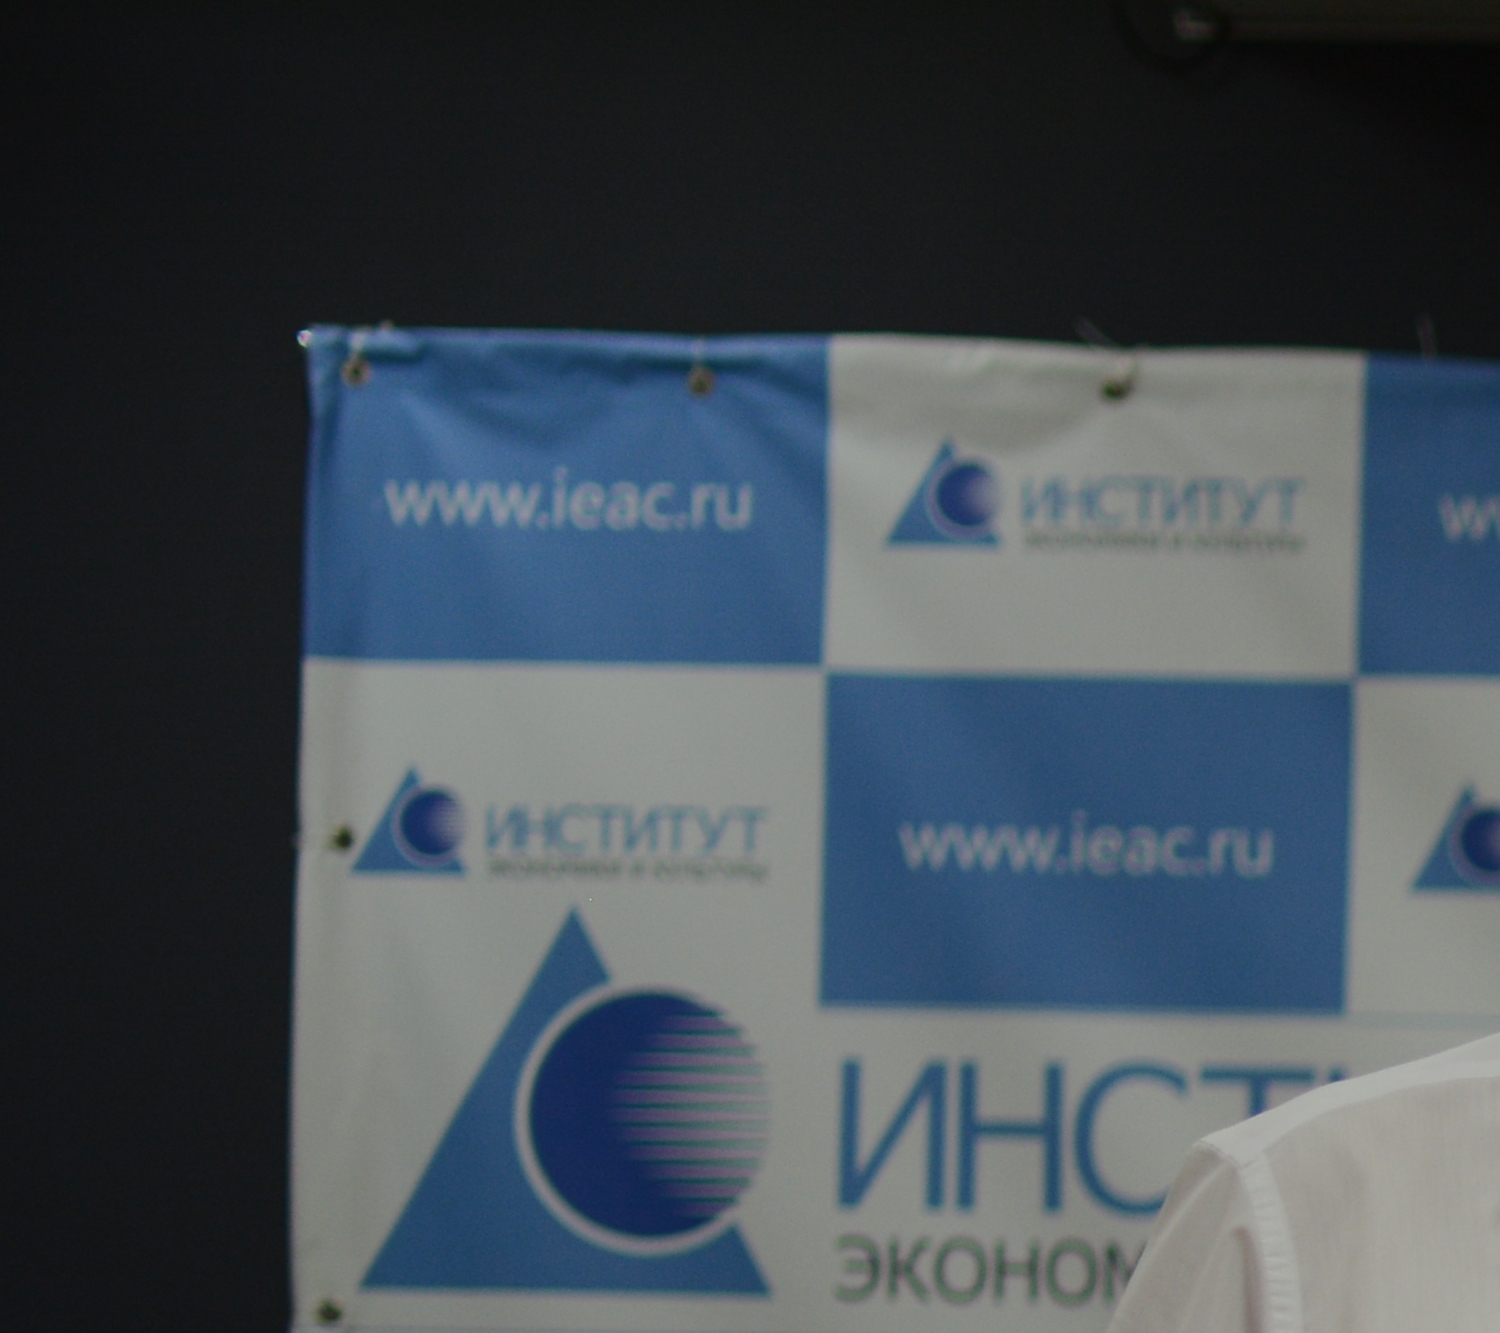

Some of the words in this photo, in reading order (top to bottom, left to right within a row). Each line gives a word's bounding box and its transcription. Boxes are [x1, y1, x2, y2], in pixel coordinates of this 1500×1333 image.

[386, 468, 753, 530] www.ieac.ru
[1020, 475, 1306, 528] ИНСТИТУТ
[485, 804, 769, 856] ИНСТИТУТ
[900, 810, 1273, 875] www.ieac.ru
